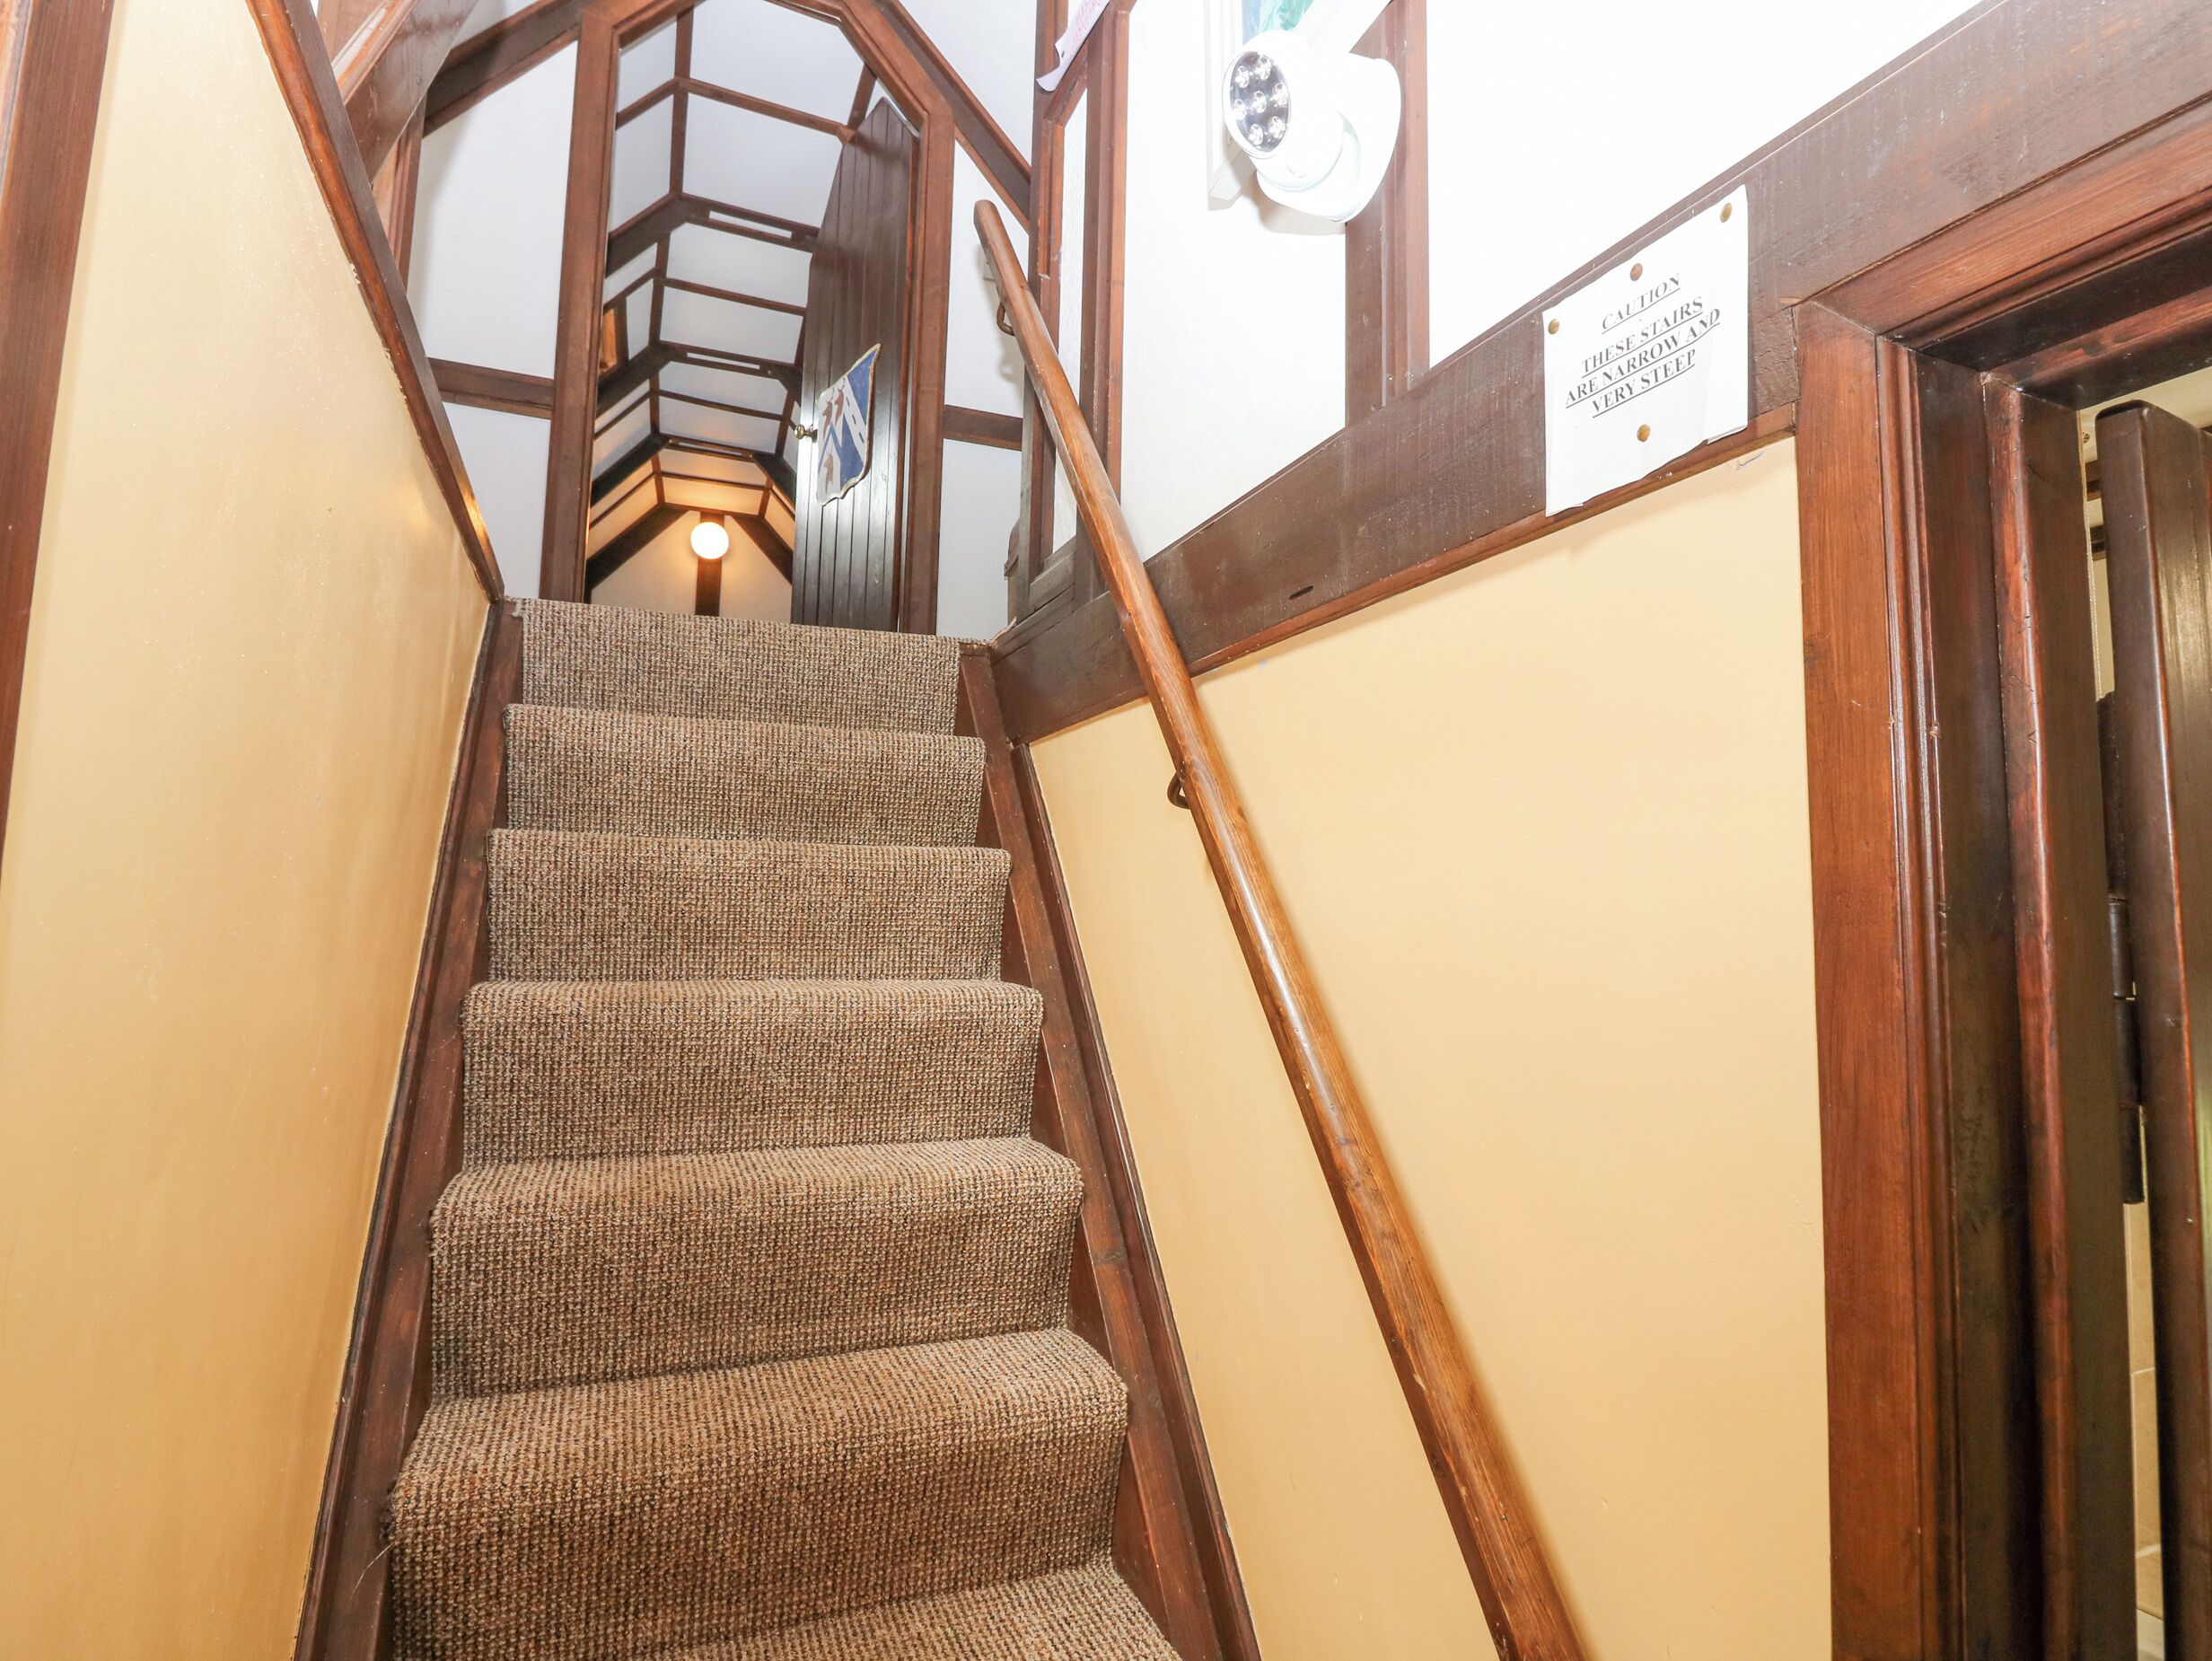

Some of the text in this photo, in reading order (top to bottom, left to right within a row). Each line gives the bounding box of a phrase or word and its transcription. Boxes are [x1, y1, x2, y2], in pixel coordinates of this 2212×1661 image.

[1582, 296, 1703, 374] THESE STAIRS
[1602, 273, 1680, 330] CAUTION
[1566, 309, 1720, 405] ARE NARROW AND
[1593, 349, 1695, 412] VERY STEEP
